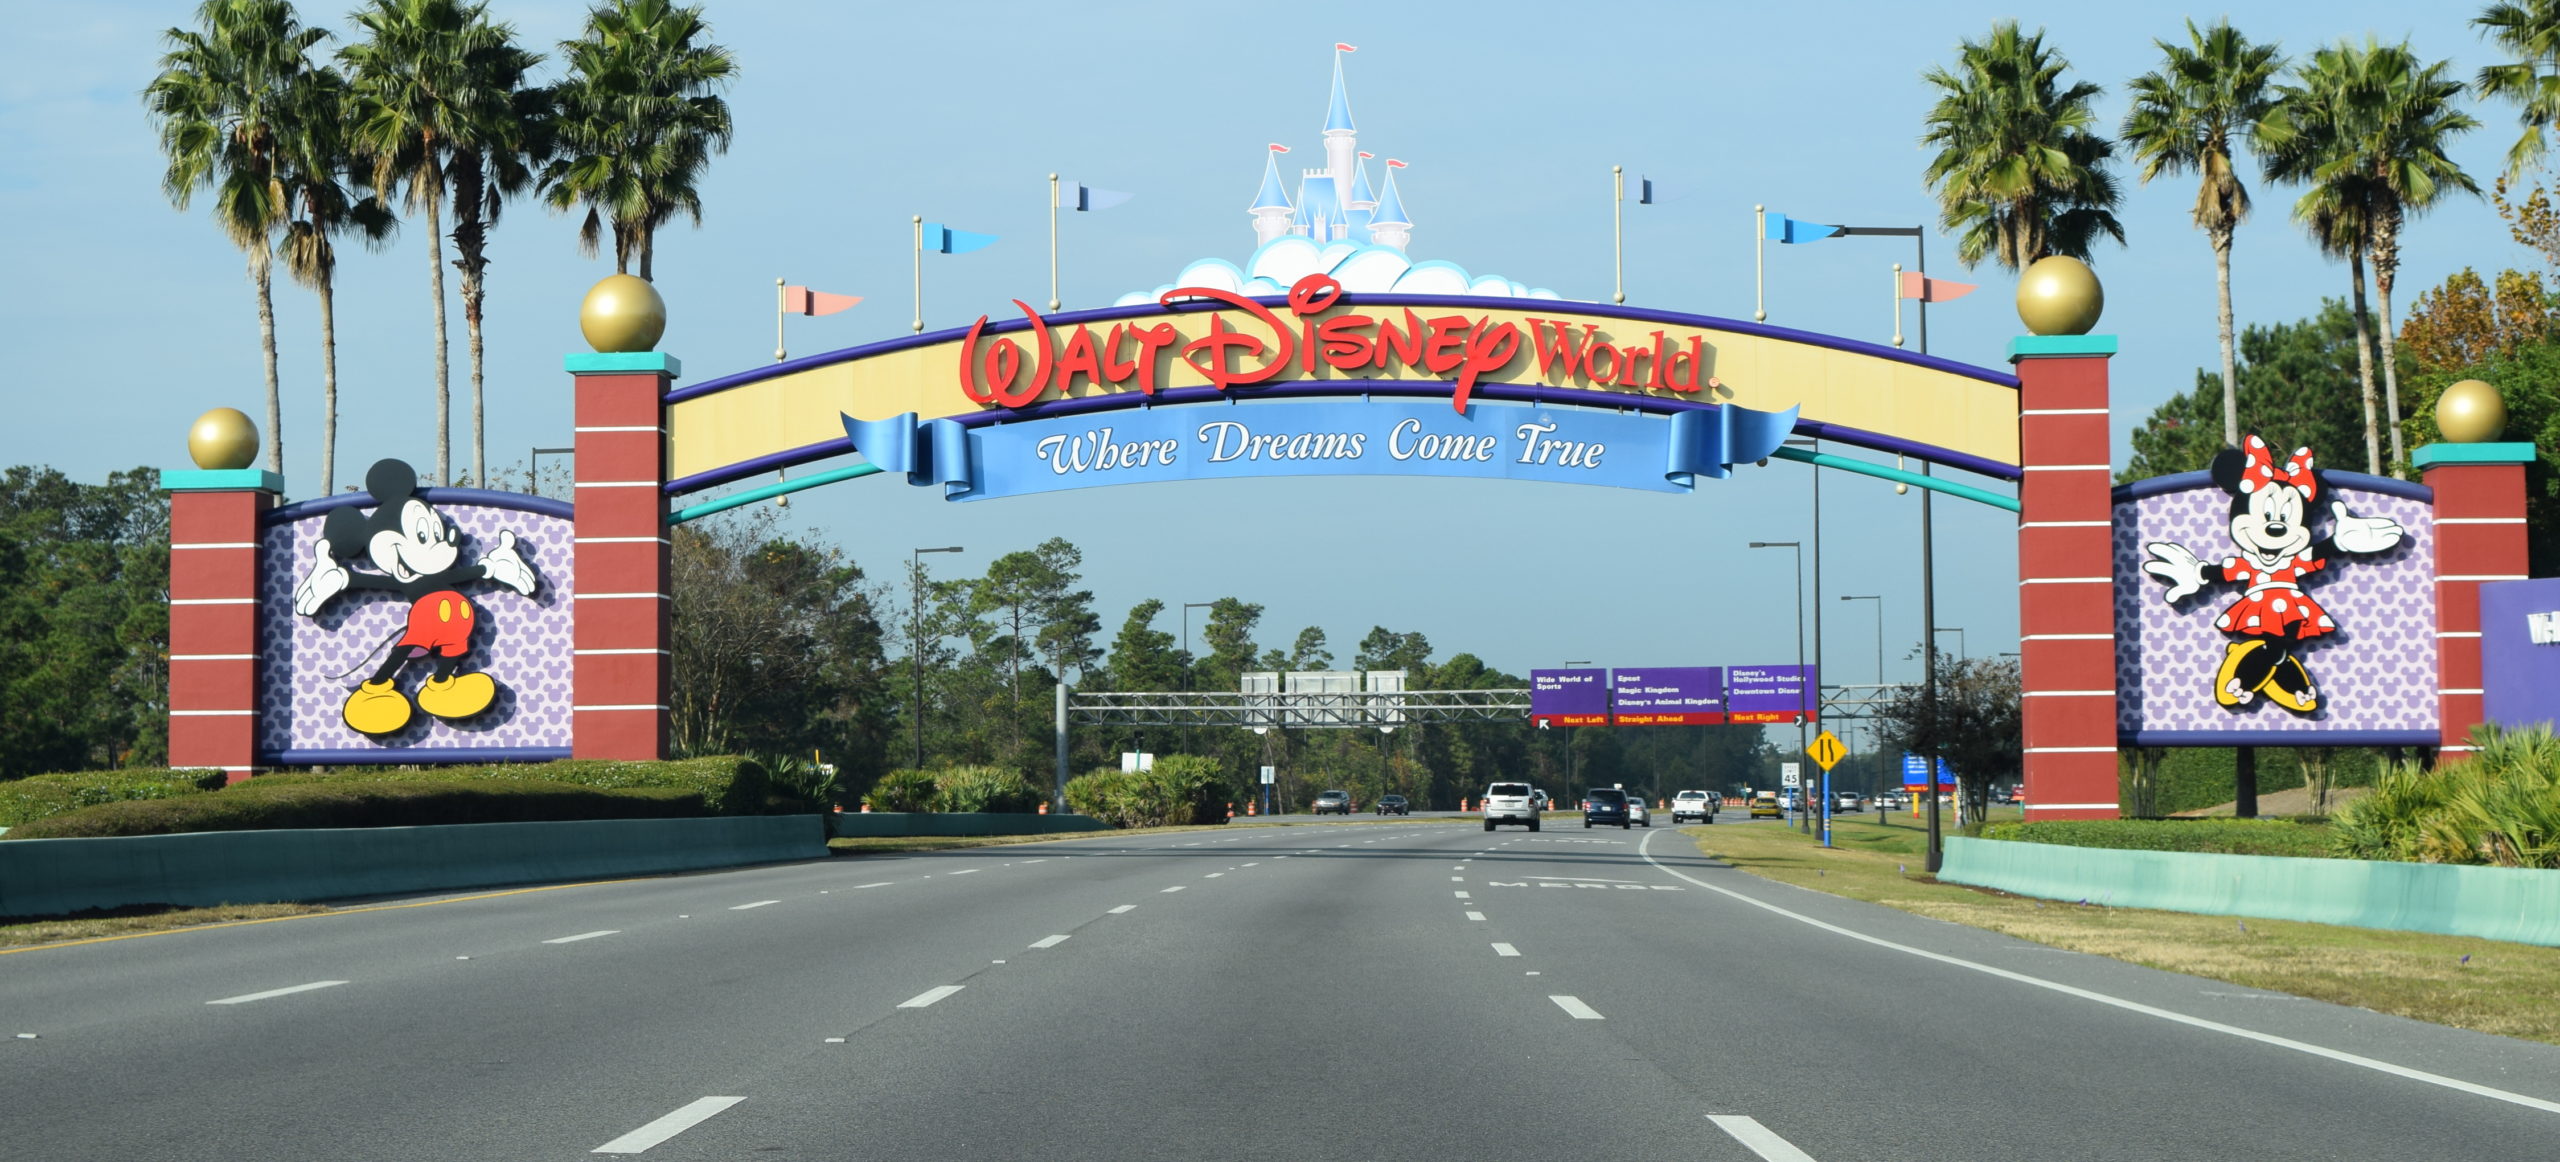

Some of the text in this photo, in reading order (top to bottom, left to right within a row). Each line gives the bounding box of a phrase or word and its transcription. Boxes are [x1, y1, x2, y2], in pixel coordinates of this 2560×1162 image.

[1526, 317, 1703, 393] World
[1035, 417, 1606, 474] Where Dreams Come True
[1733, 676, 1774, 684] Hollywood
[1618, 698, 1651, 706] Disney's
[1685, 698, 1719, 706] Kingdom
[1619, 716, 1653, 724] Straight
[1757, 713, 1779, 722] Right
[1784, 774, 1797, 783] 45
